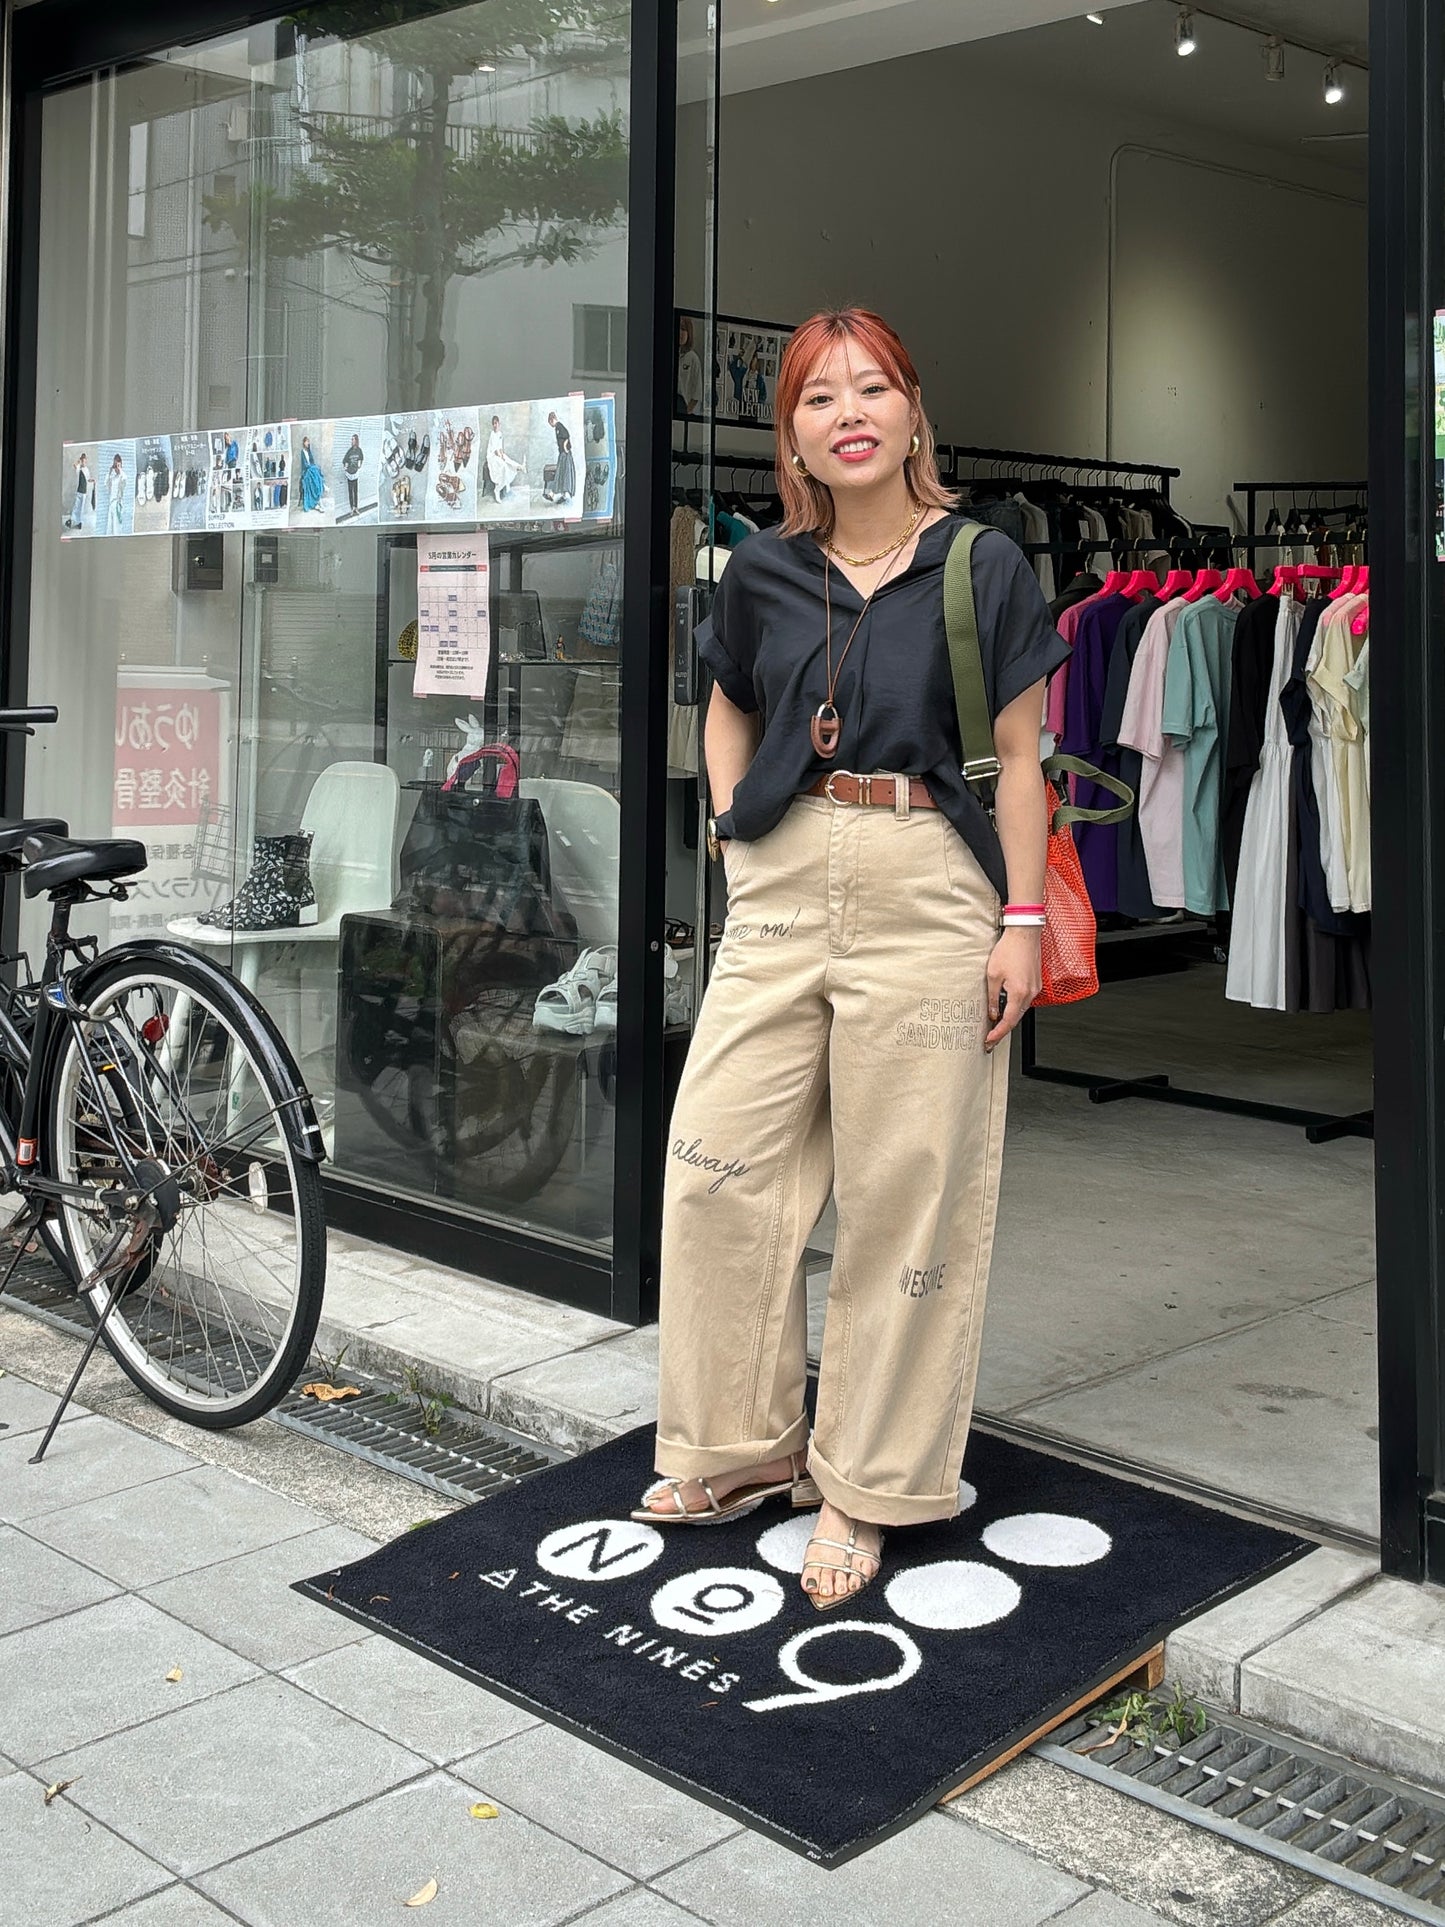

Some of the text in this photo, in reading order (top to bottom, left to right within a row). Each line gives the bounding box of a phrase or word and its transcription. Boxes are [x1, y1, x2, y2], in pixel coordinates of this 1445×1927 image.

[742, 388, 760, 403] NEW
[726, 400, 774, 418] COLLECTION
[920, 998, 983, 1023] SPECIAL
[672, 1138, 751, 1194] always
[519, 1580, 741, 1694] THE NINES
